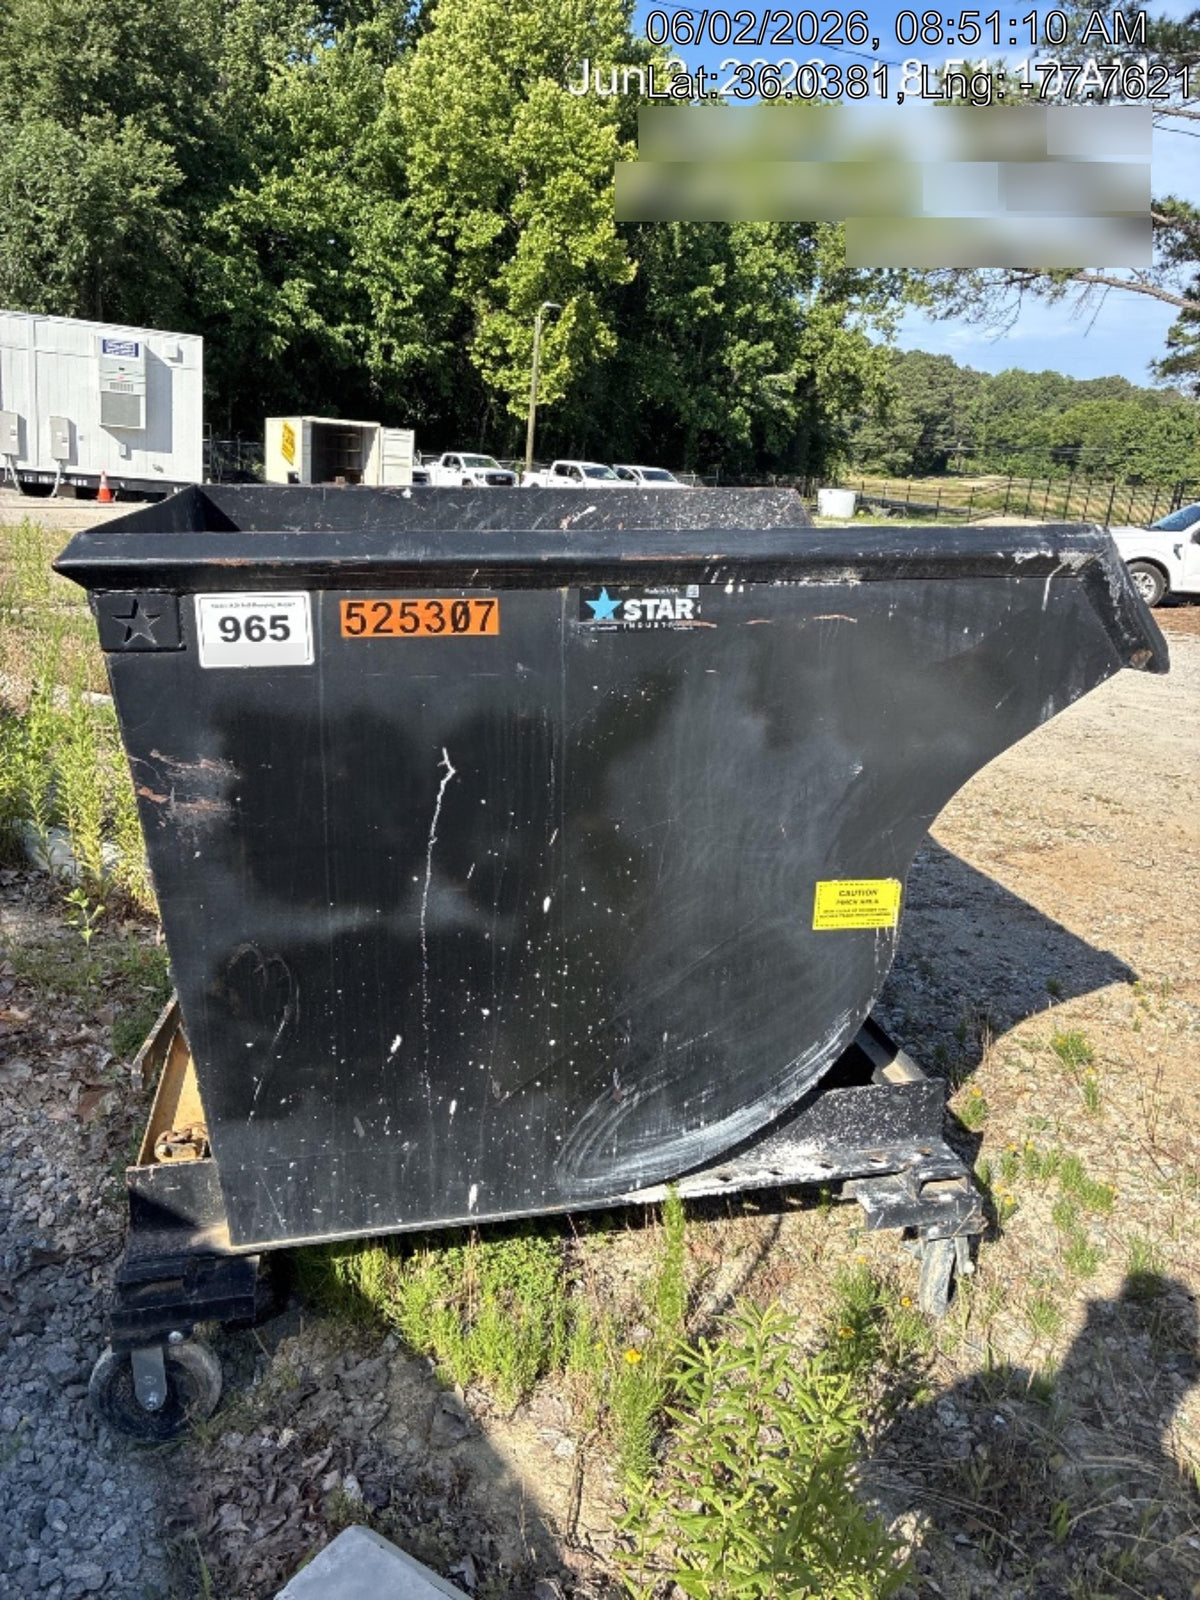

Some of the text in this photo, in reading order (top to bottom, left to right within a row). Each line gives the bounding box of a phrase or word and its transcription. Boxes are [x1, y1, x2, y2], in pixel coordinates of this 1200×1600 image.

[345, 600, 495, 635] 525307
[623, 599, 694, 620] STAR
[218, 615, 291, 643] 965
[839, 889, 877, 897] CAUTION
